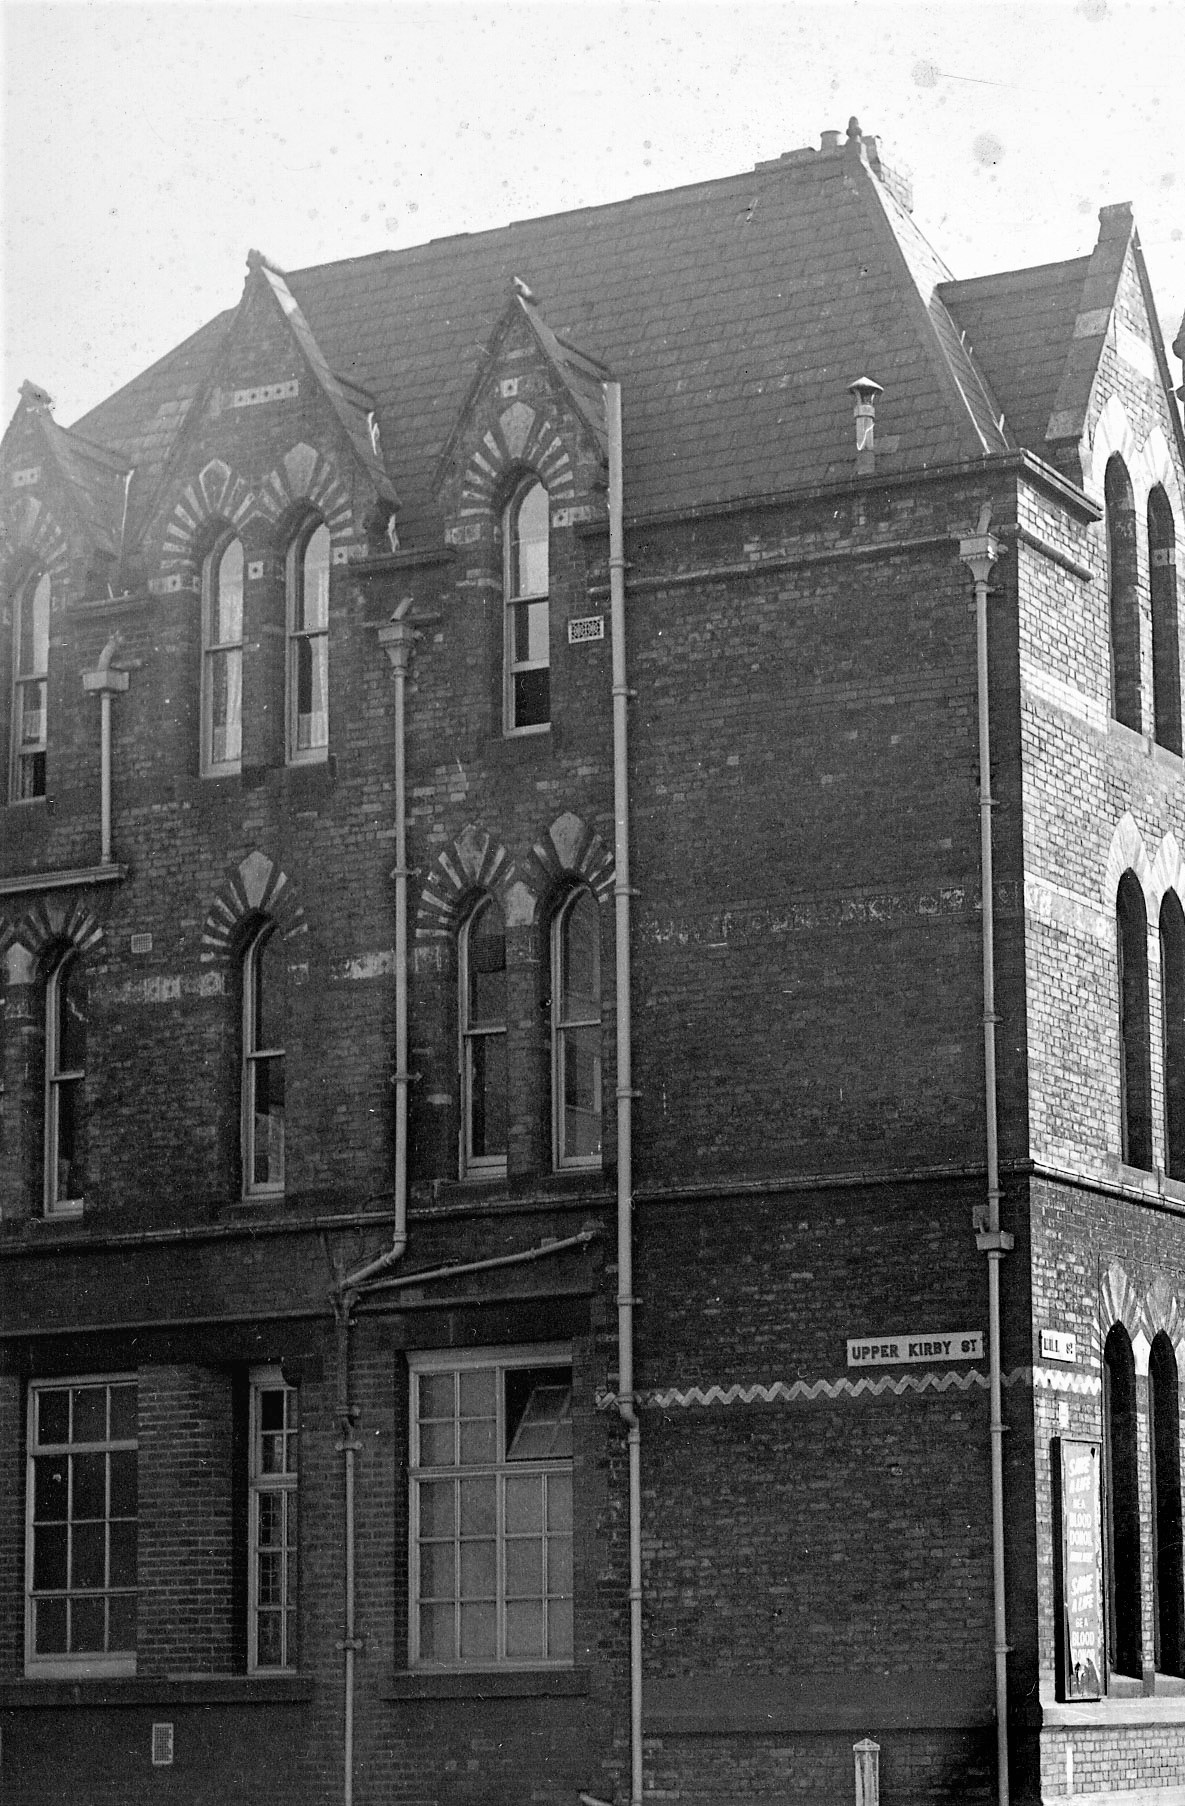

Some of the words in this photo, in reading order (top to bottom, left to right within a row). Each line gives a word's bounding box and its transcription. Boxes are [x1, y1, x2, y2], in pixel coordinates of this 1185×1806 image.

[852, 1344, 899, 1360] UPPER
[908, 1340, 952, 1357] KIRBY
[1069, 1512, 1092, 1529] BLOOD
[1070, 1574, 1094, 1596] SAVE
[1071, 1598, 1077, 1612] A
[1078, 1593, 1094, 1612] LIFE
[1072, 1631, 1095, 1647] BLOOD
